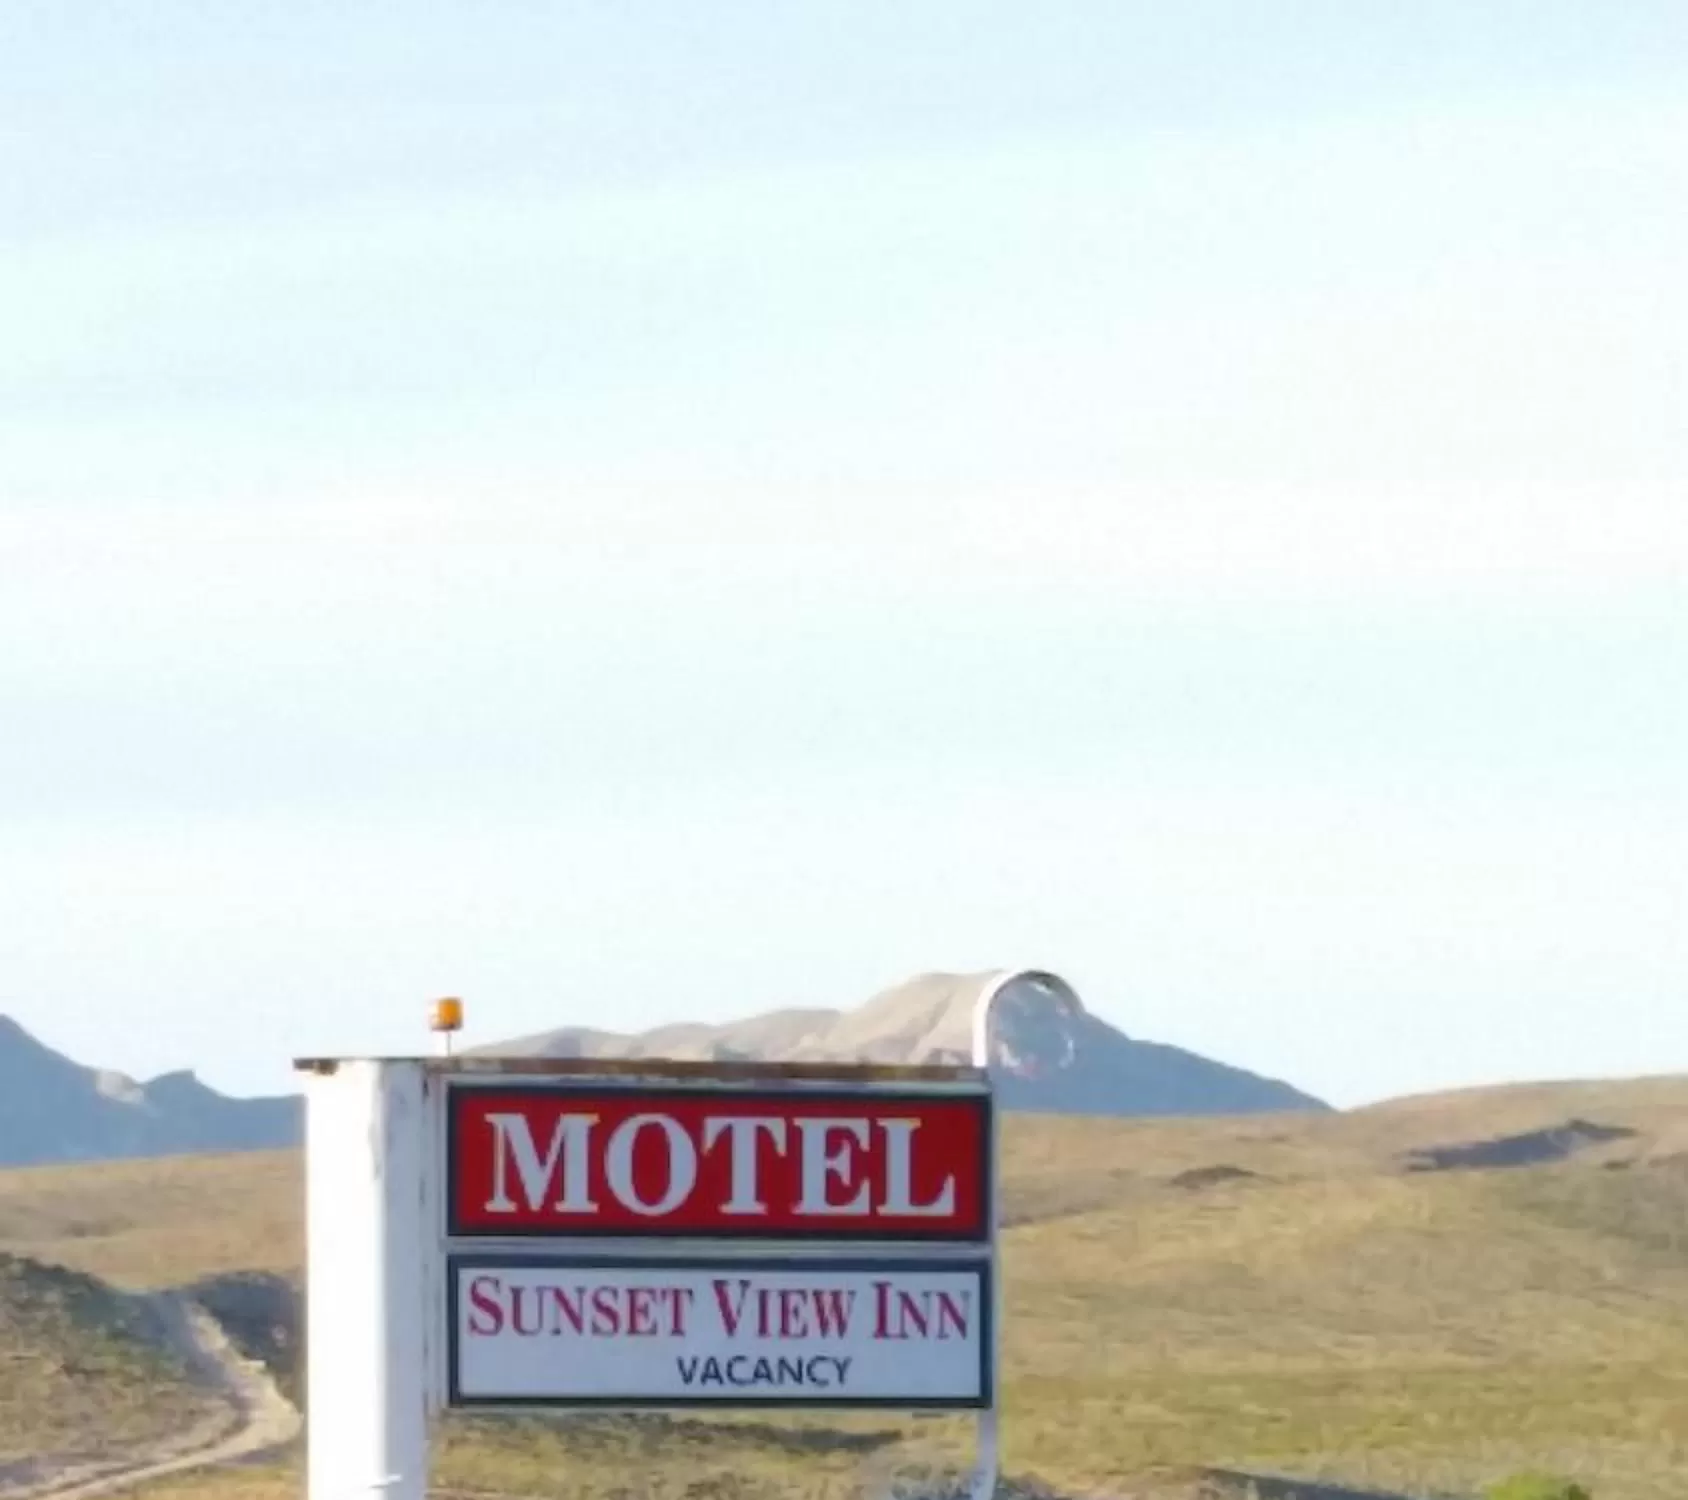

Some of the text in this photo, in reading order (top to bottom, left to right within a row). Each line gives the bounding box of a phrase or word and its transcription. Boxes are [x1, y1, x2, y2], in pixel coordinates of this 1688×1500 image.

[484, 1112, 956, 1216] MOTEL
[468, 1276, 972, 1339] SUNSET VIEW INN
[677, 1355, 852, 1386] VACANCY
